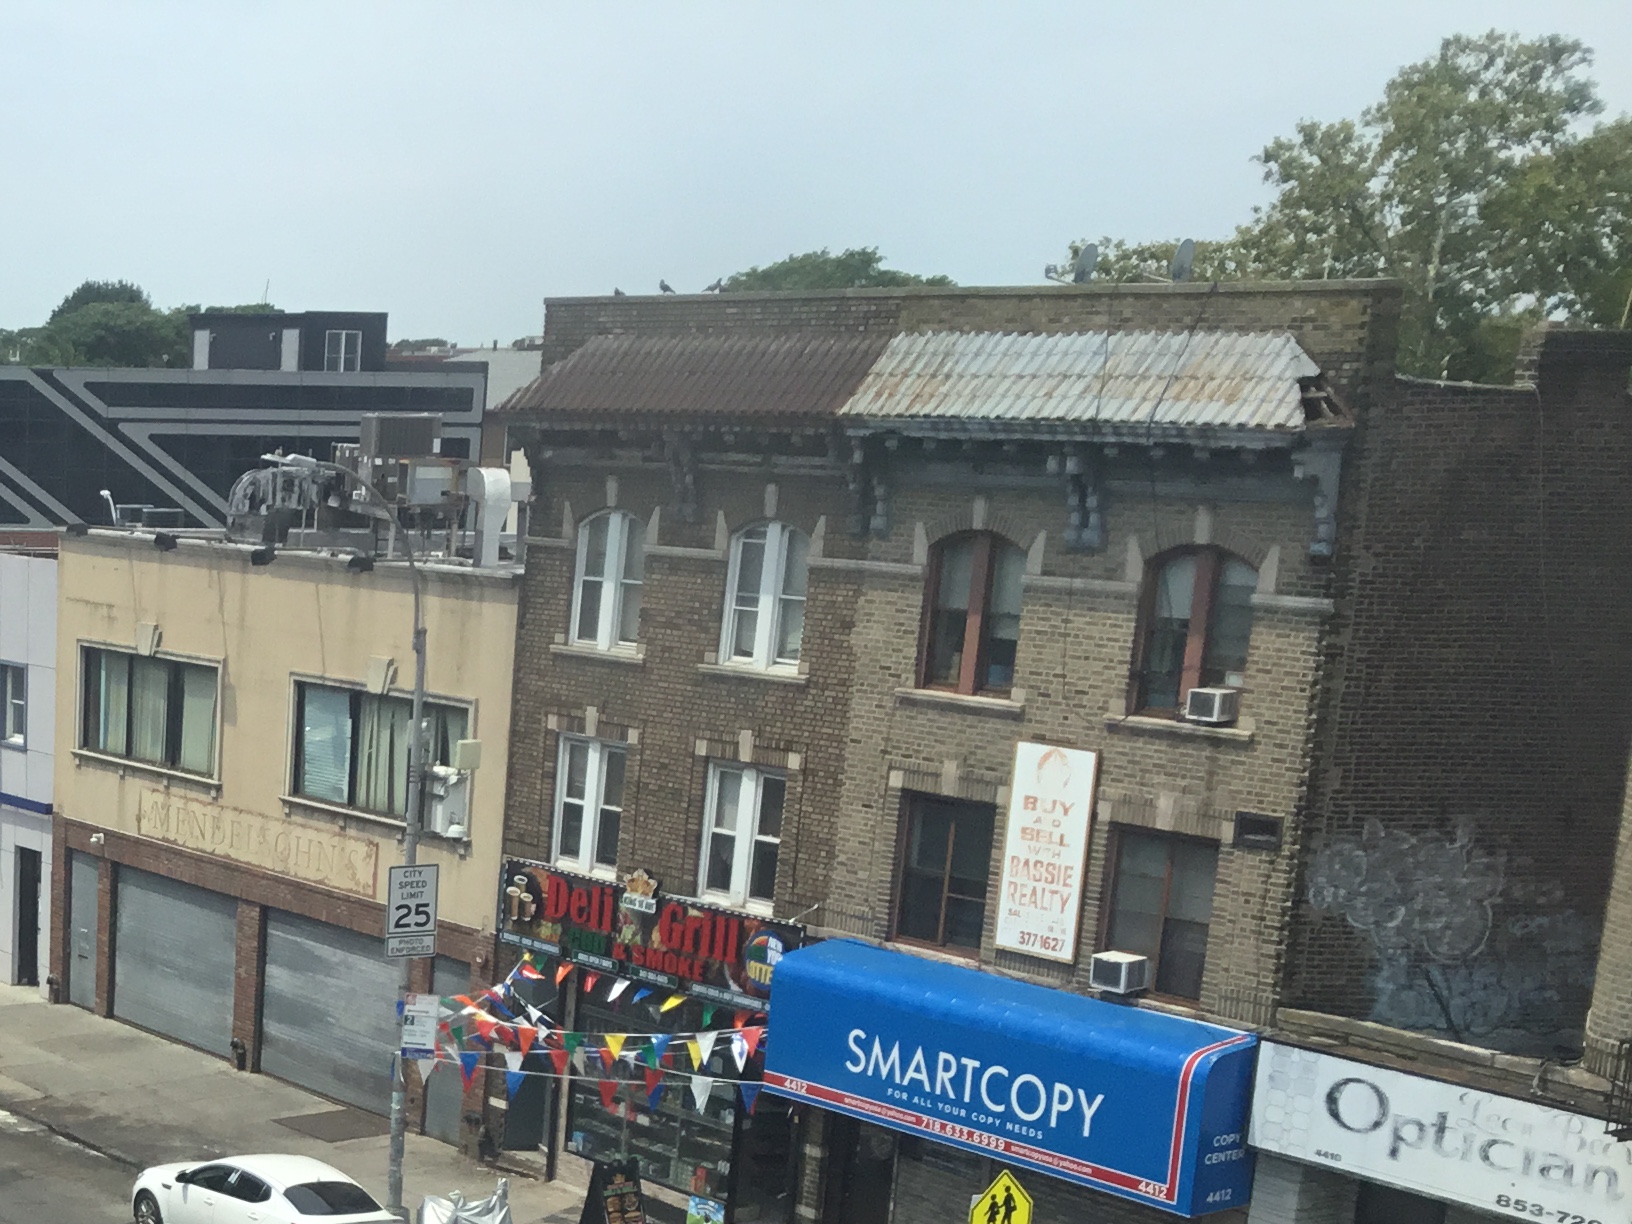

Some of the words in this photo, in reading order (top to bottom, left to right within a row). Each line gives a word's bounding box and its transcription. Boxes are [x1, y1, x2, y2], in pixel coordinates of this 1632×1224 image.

[1033, 816, 1061, 828] AD
[1020, 826, 1070, 847] SELL
[403, 870, 423, 878] CITY
[1009, 855, 1074, 888] BASSIE
[398, 880, 428, 889] SPEED
[401, 891, 425, 900] LIMIT
[1007, 881, 1071, 914] REALTY
[394, 903, 431, 928] 25
[542, 874, 614, 933] Deli
[658, 902, 739, 964] Grill
[390, 945, 432, 954] ENFORCED
[398, 938, 424, 946] PHOTO
[631, 944, 703, 982] SMOKE
[845, 1028, 1104, 1137] SMARTCOPY
[886, 1088, 908, 1101] FOR
[912, 1095, 932, 1108] ALL
[937, 1102, 967, 1117] YOUR
[971, 1112, 1002, 1127] COPY
[1005, 1122, 1043, 1139] NEEDS
[784, 1079, 808, 1094] 4412
[920, 1117, 1006, 1151] 718.633.6999
[1138, 1181, 1168, 1199] 4412
[1213, 1133, 1241, 1147] COPY
[1325, 1077, 1624, 1202] Optician
[1204, 1149, 1246, 1165] CENTER
[1206, 1188, 1232, 1203] 4412
